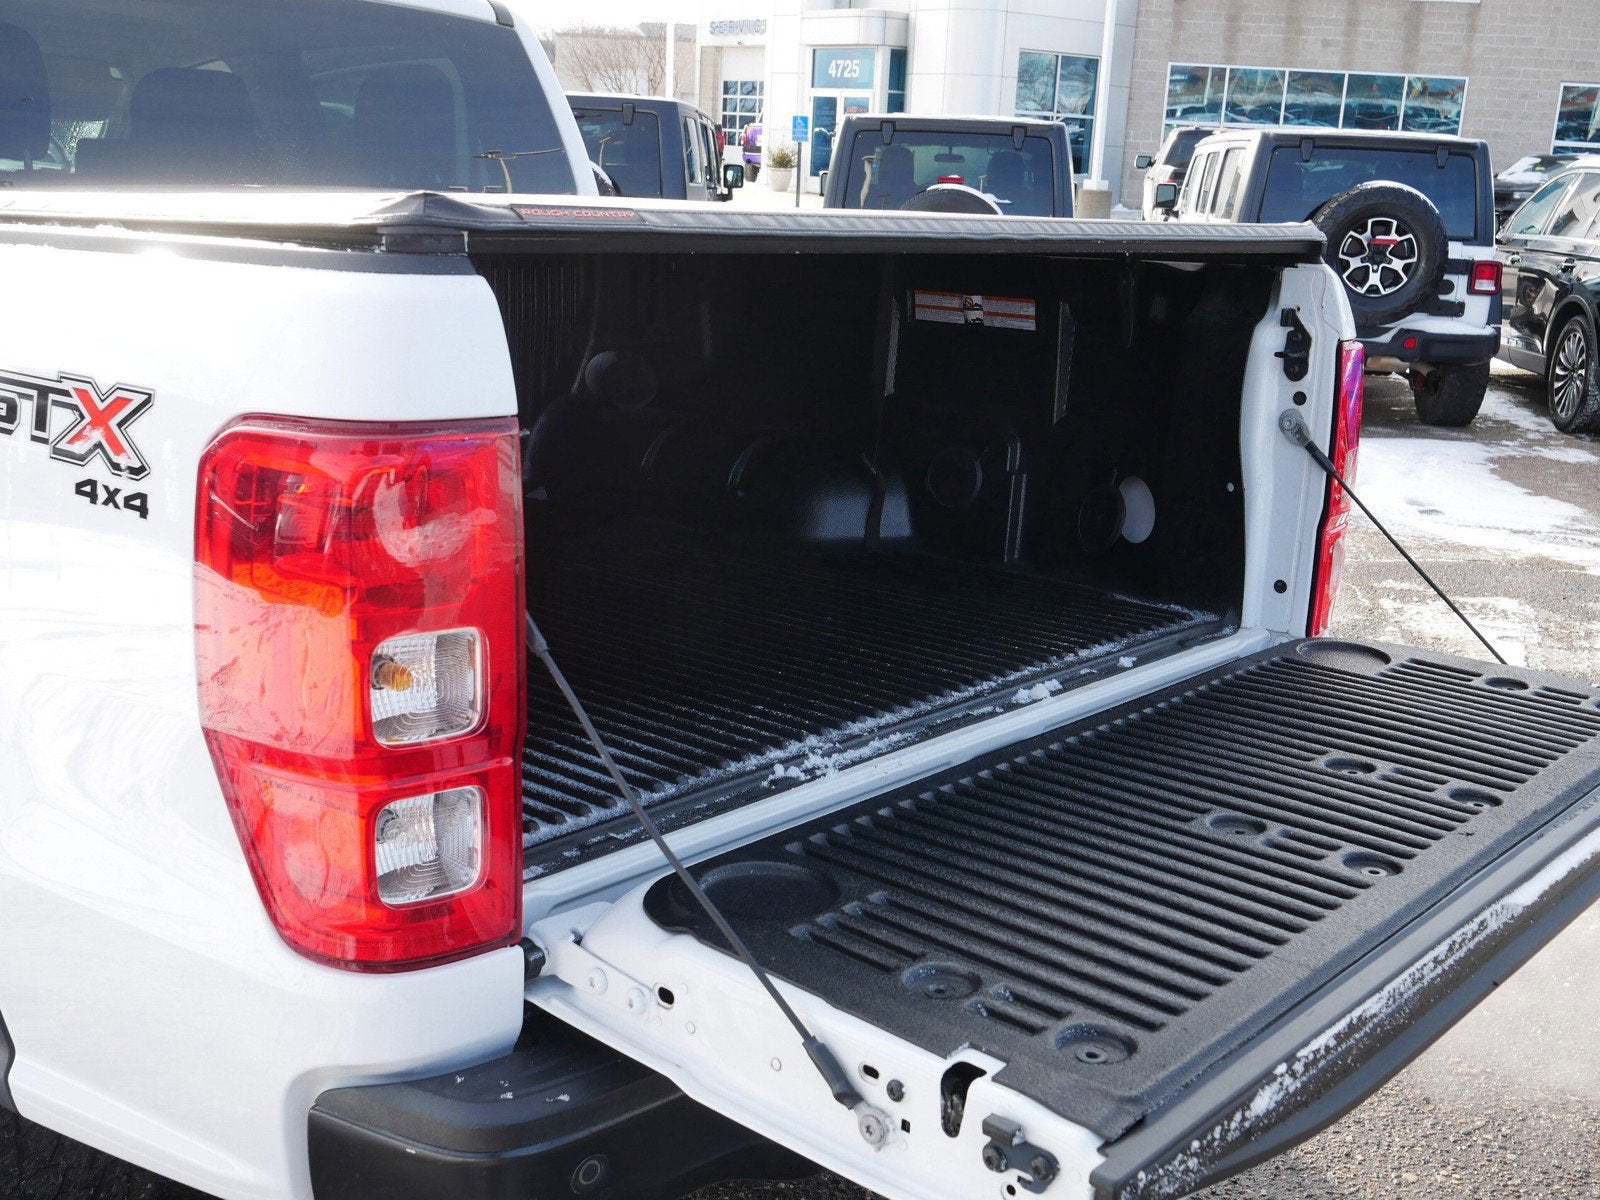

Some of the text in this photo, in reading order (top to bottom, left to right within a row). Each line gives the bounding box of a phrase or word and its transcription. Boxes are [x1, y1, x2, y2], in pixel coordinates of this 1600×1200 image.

[709, 19, 767, 35] SERVIC
[828, 59, 860, 78] 4725
[520, 207, 635, 219] ROUGH COUNTRY
